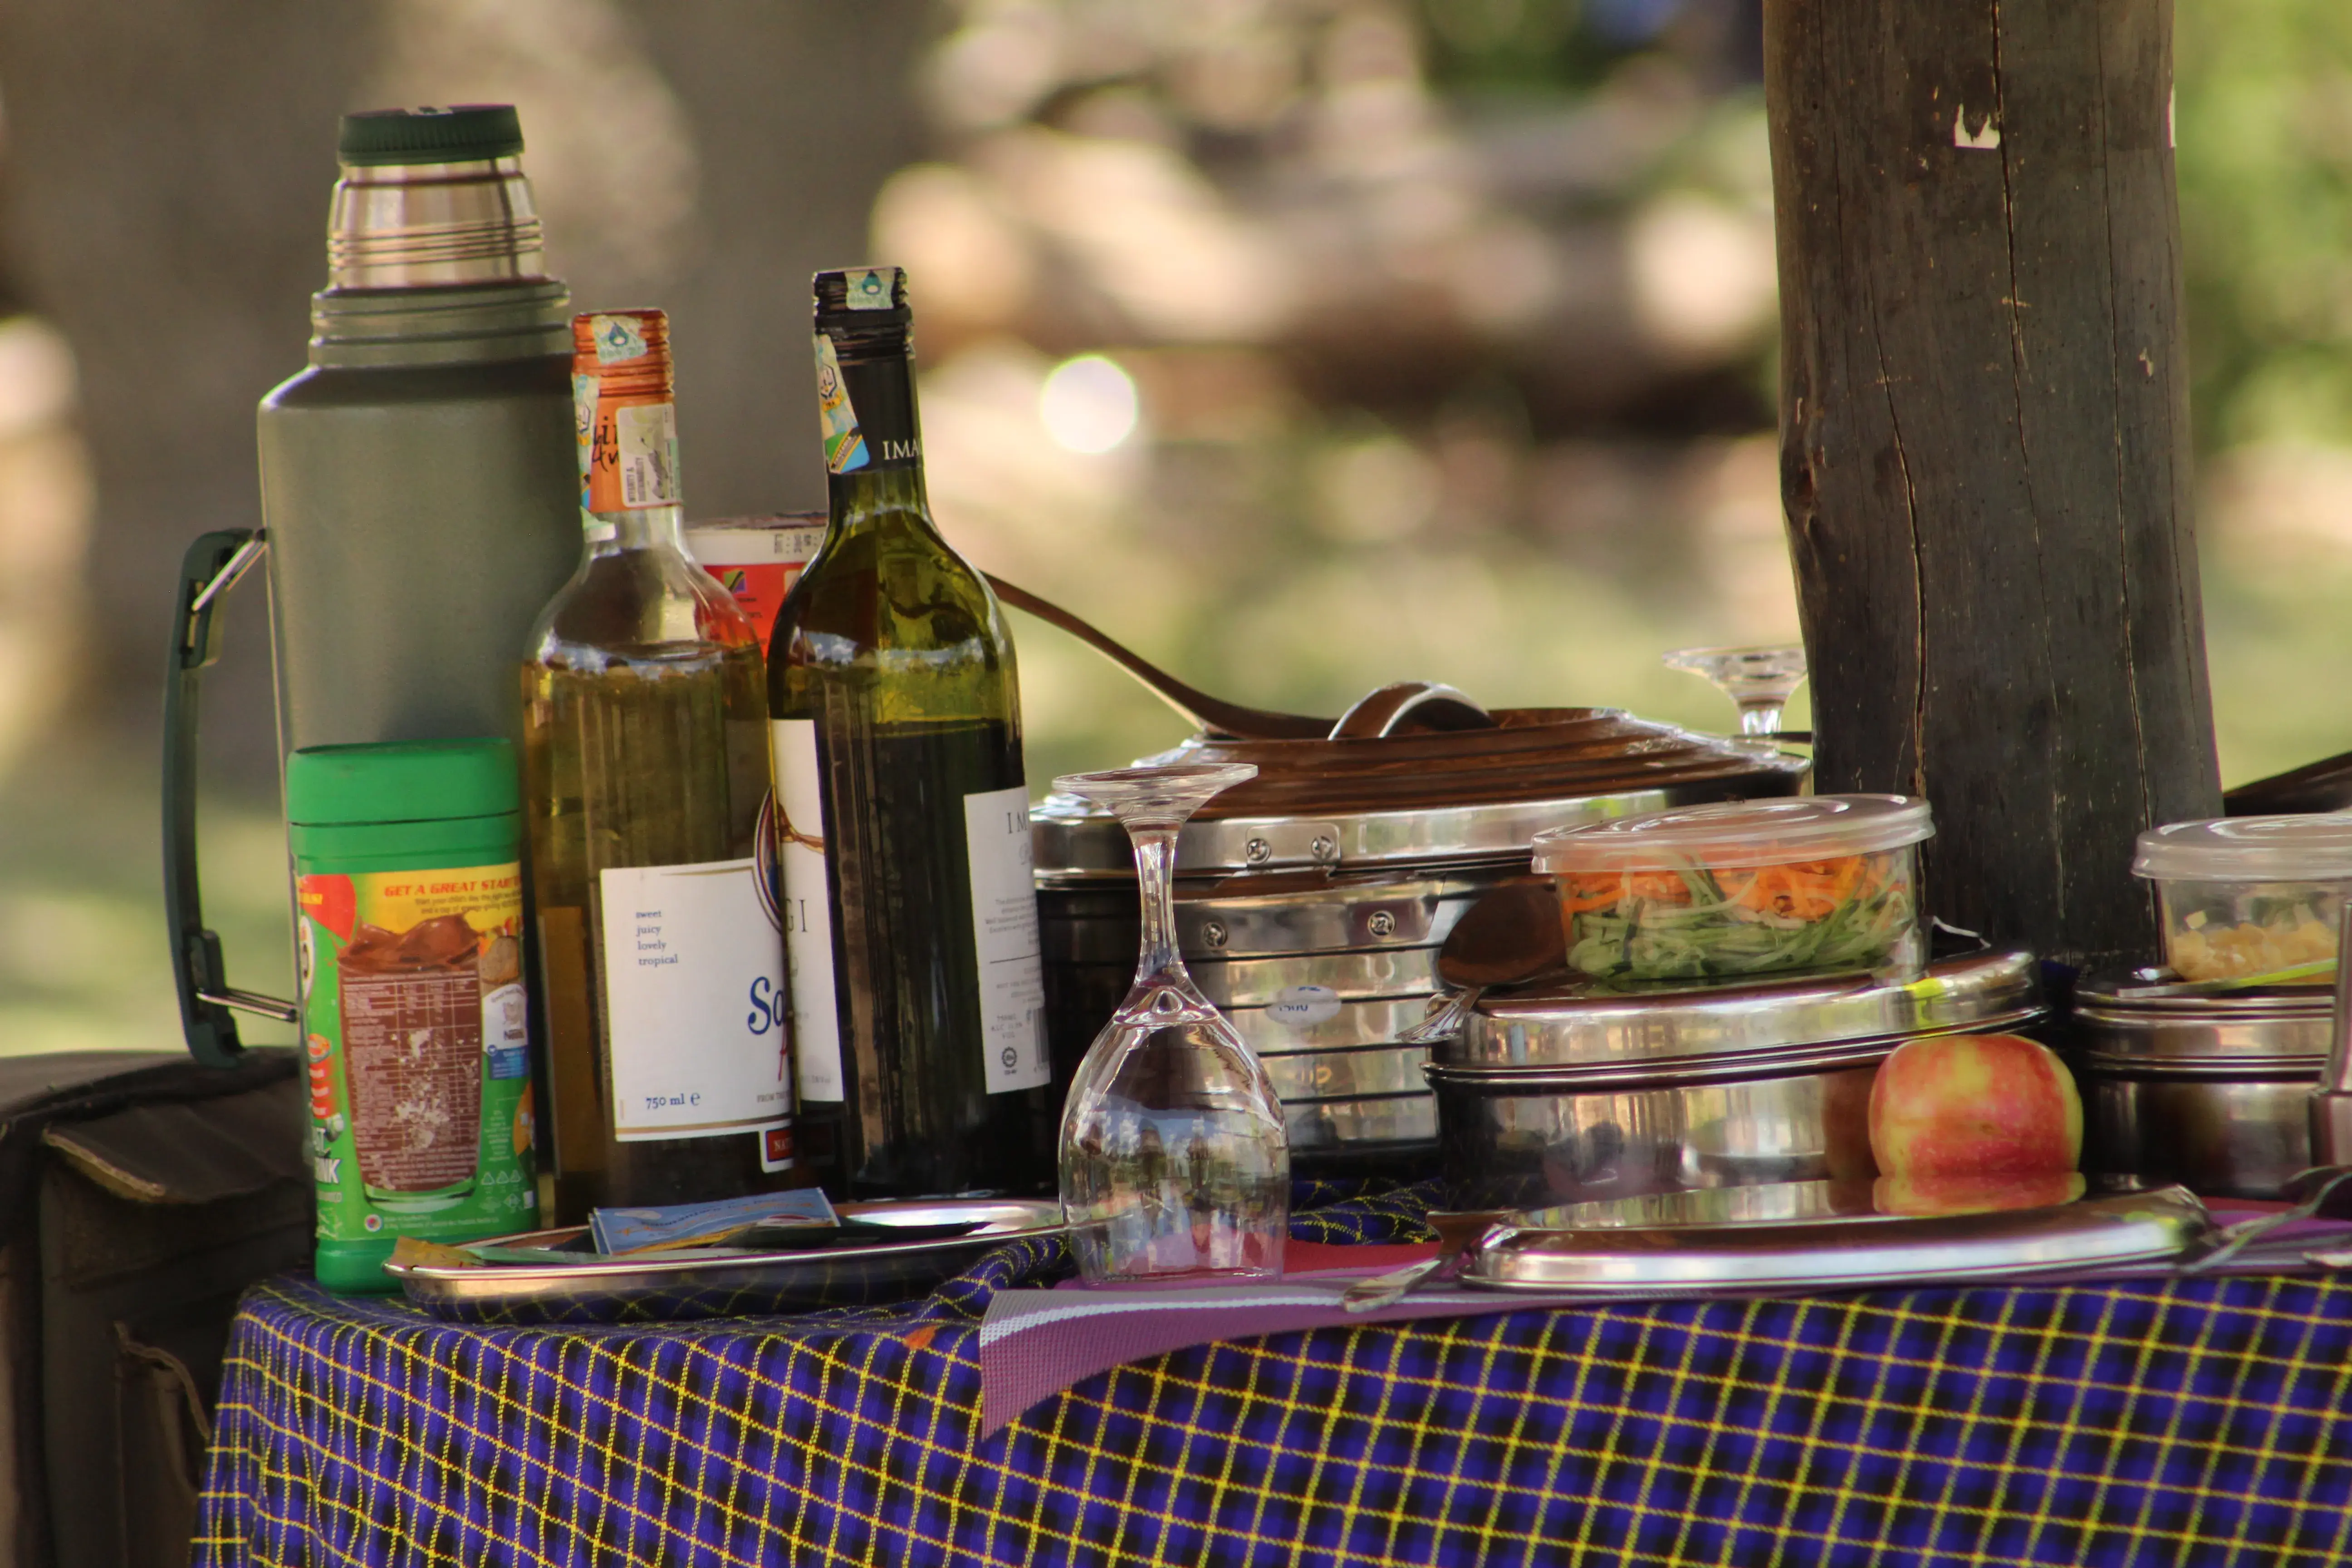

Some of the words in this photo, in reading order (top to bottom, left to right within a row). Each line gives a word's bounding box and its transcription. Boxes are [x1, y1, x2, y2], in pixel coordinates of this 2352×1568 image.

[384, 885, 411, 897] GET
[415, 884, 426, 895] A
[430, 881, 477, 894] GREAT
[636, 910, 662, 919] sweet
[636, 925, 662, 937] juicy
[637, 939, 667, 953] lovely
[638, 953, 678, 968] tropical
[646, 1096, 667, 1110] 750
[669, 1093, 686, 1106] ml
